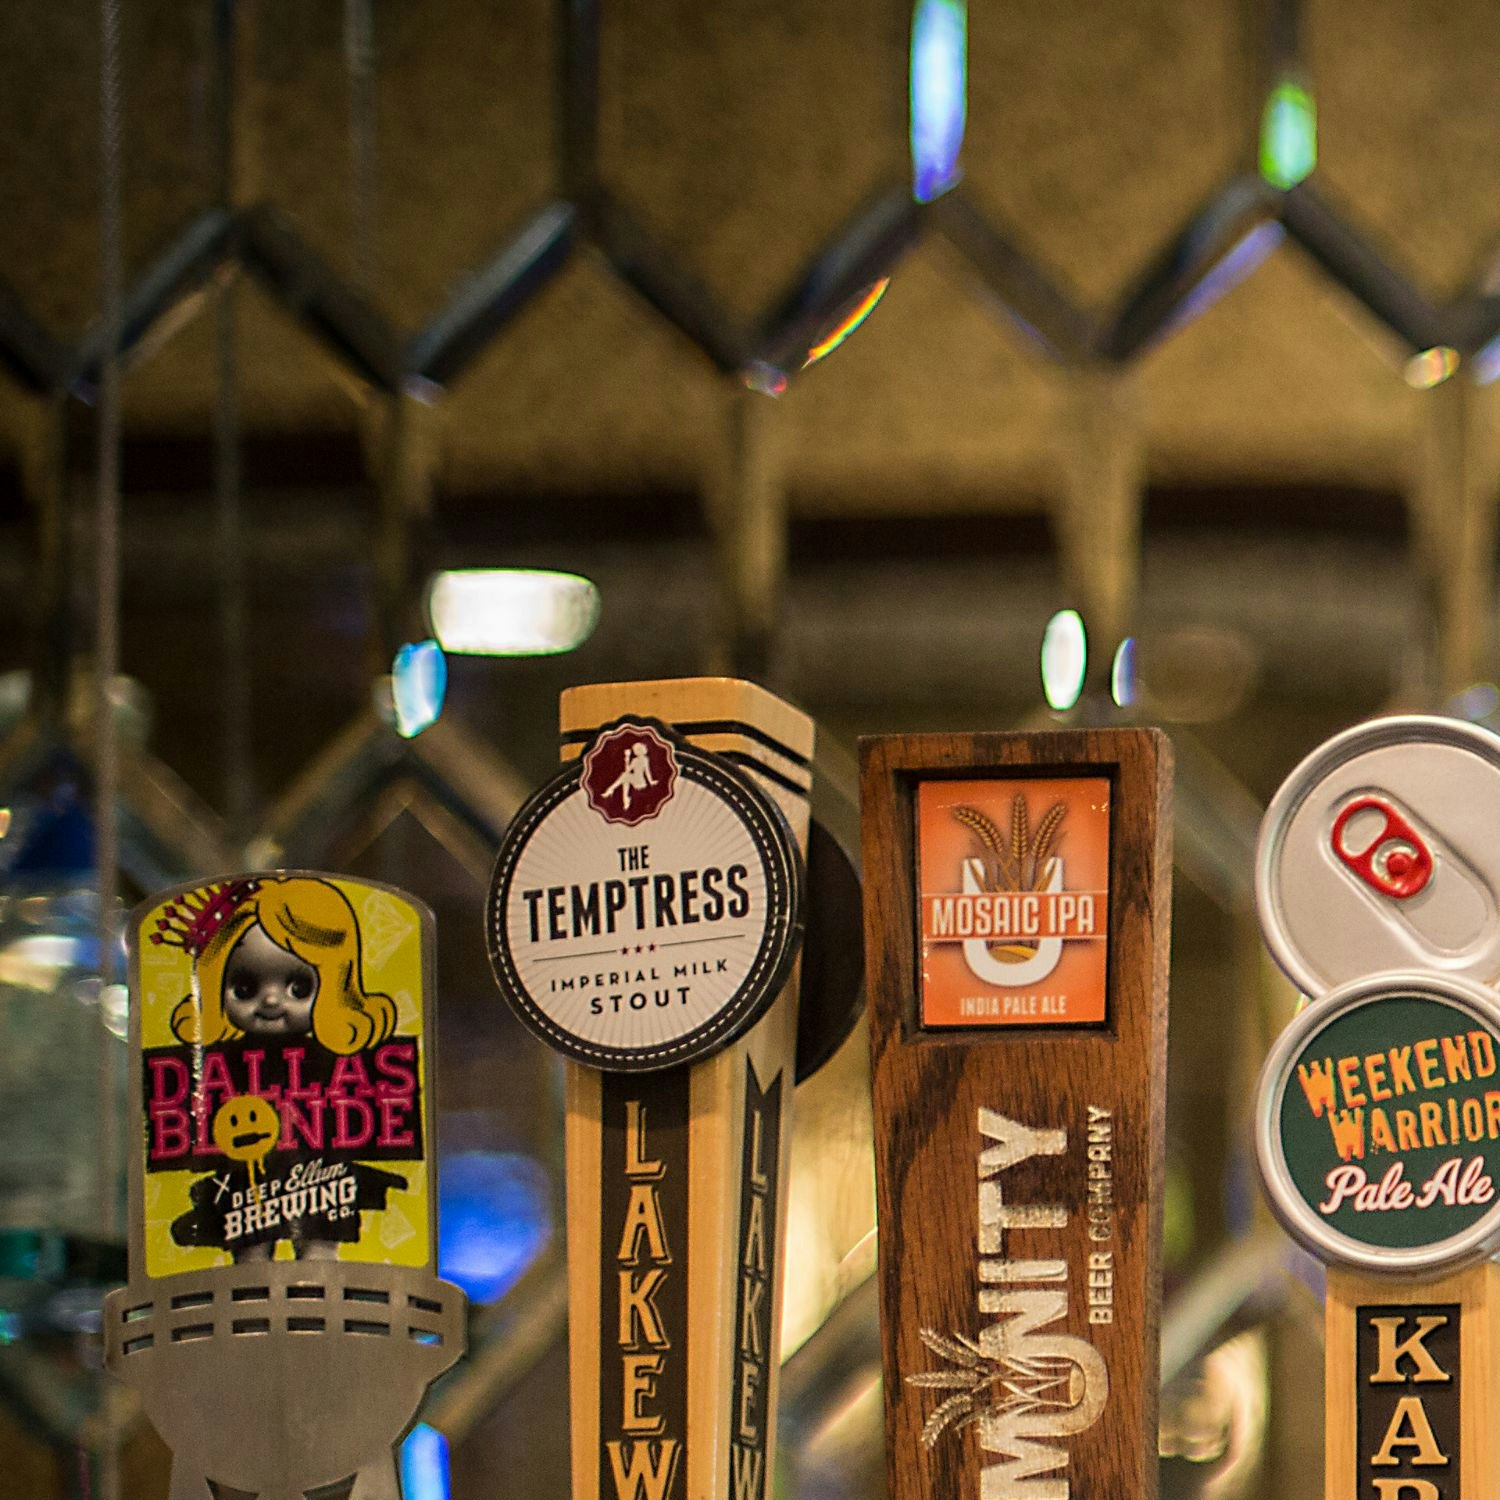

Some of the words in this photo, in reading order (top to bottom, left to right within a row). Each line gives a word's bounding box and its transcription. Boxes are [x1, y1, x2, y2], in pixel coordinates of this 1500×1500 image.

[617, 845, 650, 872] THE
[522, 863, 751, 944] TEMPTRESS
[931, 895, 1040, 936] MOSAIC
[1049, 894, 1096, 934] IPA
[549, 967, 661, 993] IMPERIAL
[673, 958, 729, 978] MILK
[590, 986, 692, 1016] STOUT
[959, 997, 1001, 1016] INDIA
[1003, 996, 1037, 1015] PALE
[1041, 995, 1068, 1014] ALE
[148, 1043, 417, 1107] DALLAS
[1298, 1029, 1498, 1120] WEEKEND
[232, 1177, 283, 1208] DEEP
[285, 1157, 349, 1193] Ellum
[1087, 1105, 1114, 1245] COMPANY
[1319, 1162, 1416, 1216] Pale
[1416, 1155, 1496, 1210] Ale
[223, 1176, 359, 1242] BREWING
[327, 1204, 356, 1223] CO.
[1088, 1252, 1114, 1326] BEER
